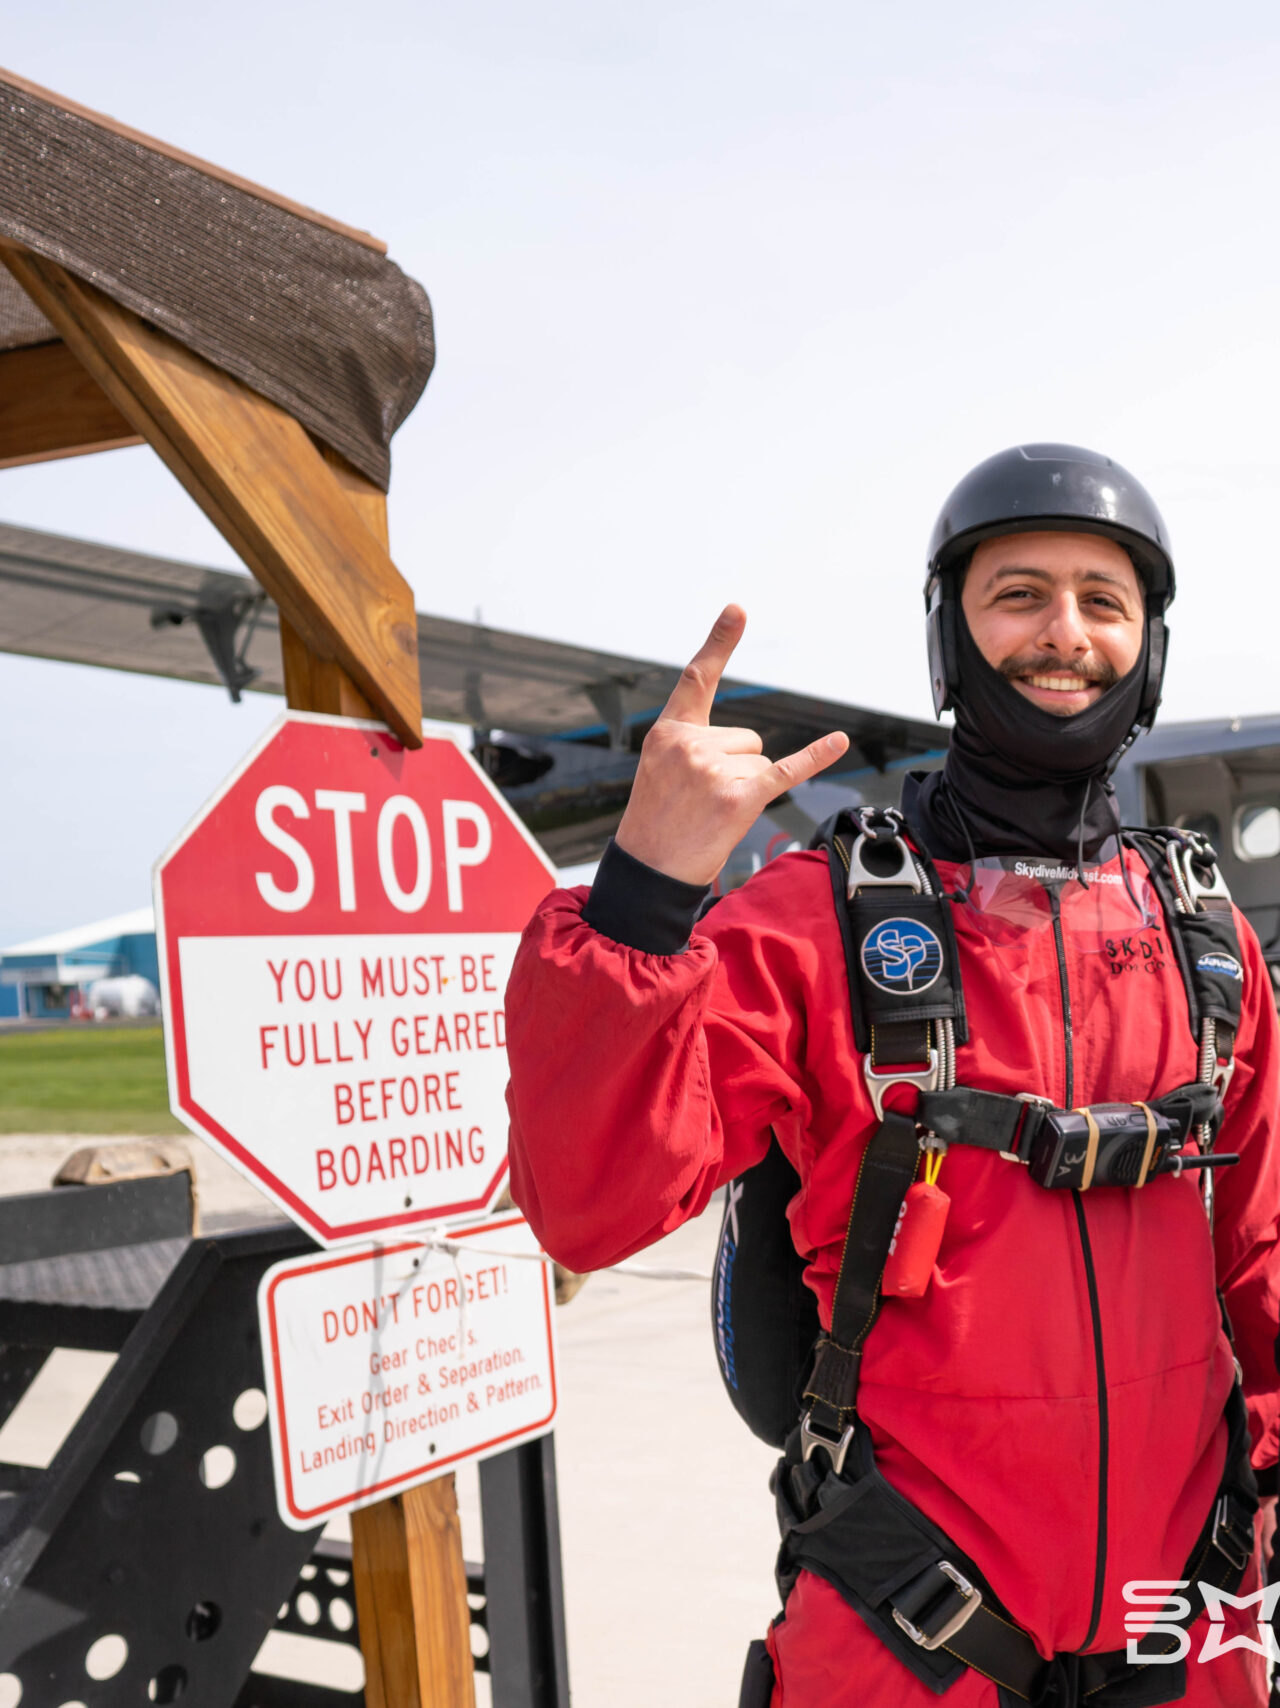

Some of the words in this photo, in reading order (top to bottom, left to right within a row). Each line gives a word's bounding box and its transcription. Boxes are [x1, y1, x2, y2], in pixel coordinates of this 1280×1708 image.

[254, 785, 492, 913] STOP
[267, 957, 343, 1003] YOU
[361, 955, 445, 999] MUST
[461, 954, 497, 992] BE
[259, 1019, 373, 1069] FULLY
[333, 1071, 462, 1125] BEFORE
[315, 1127, 486, 1192] BOARDING
[322, 1294, 401, 1343] DON'T
[369, 1347, 408, 1376] Gear
[415, 1328, 478, 1361] Checs.
[317, 1400, 354, 1430] Exit
[361, 1384, 409, 1414] Order
[417, 1374, 432, 1395] &
[438, 1347, 525, 1389] Separation.
[300, 1430, 376, 1474] Landing
[383, 1402, 460, 1444] Direction
[466, 1390, 480, 1412] &
[486, 1372, 543, 1407] Pattern.
